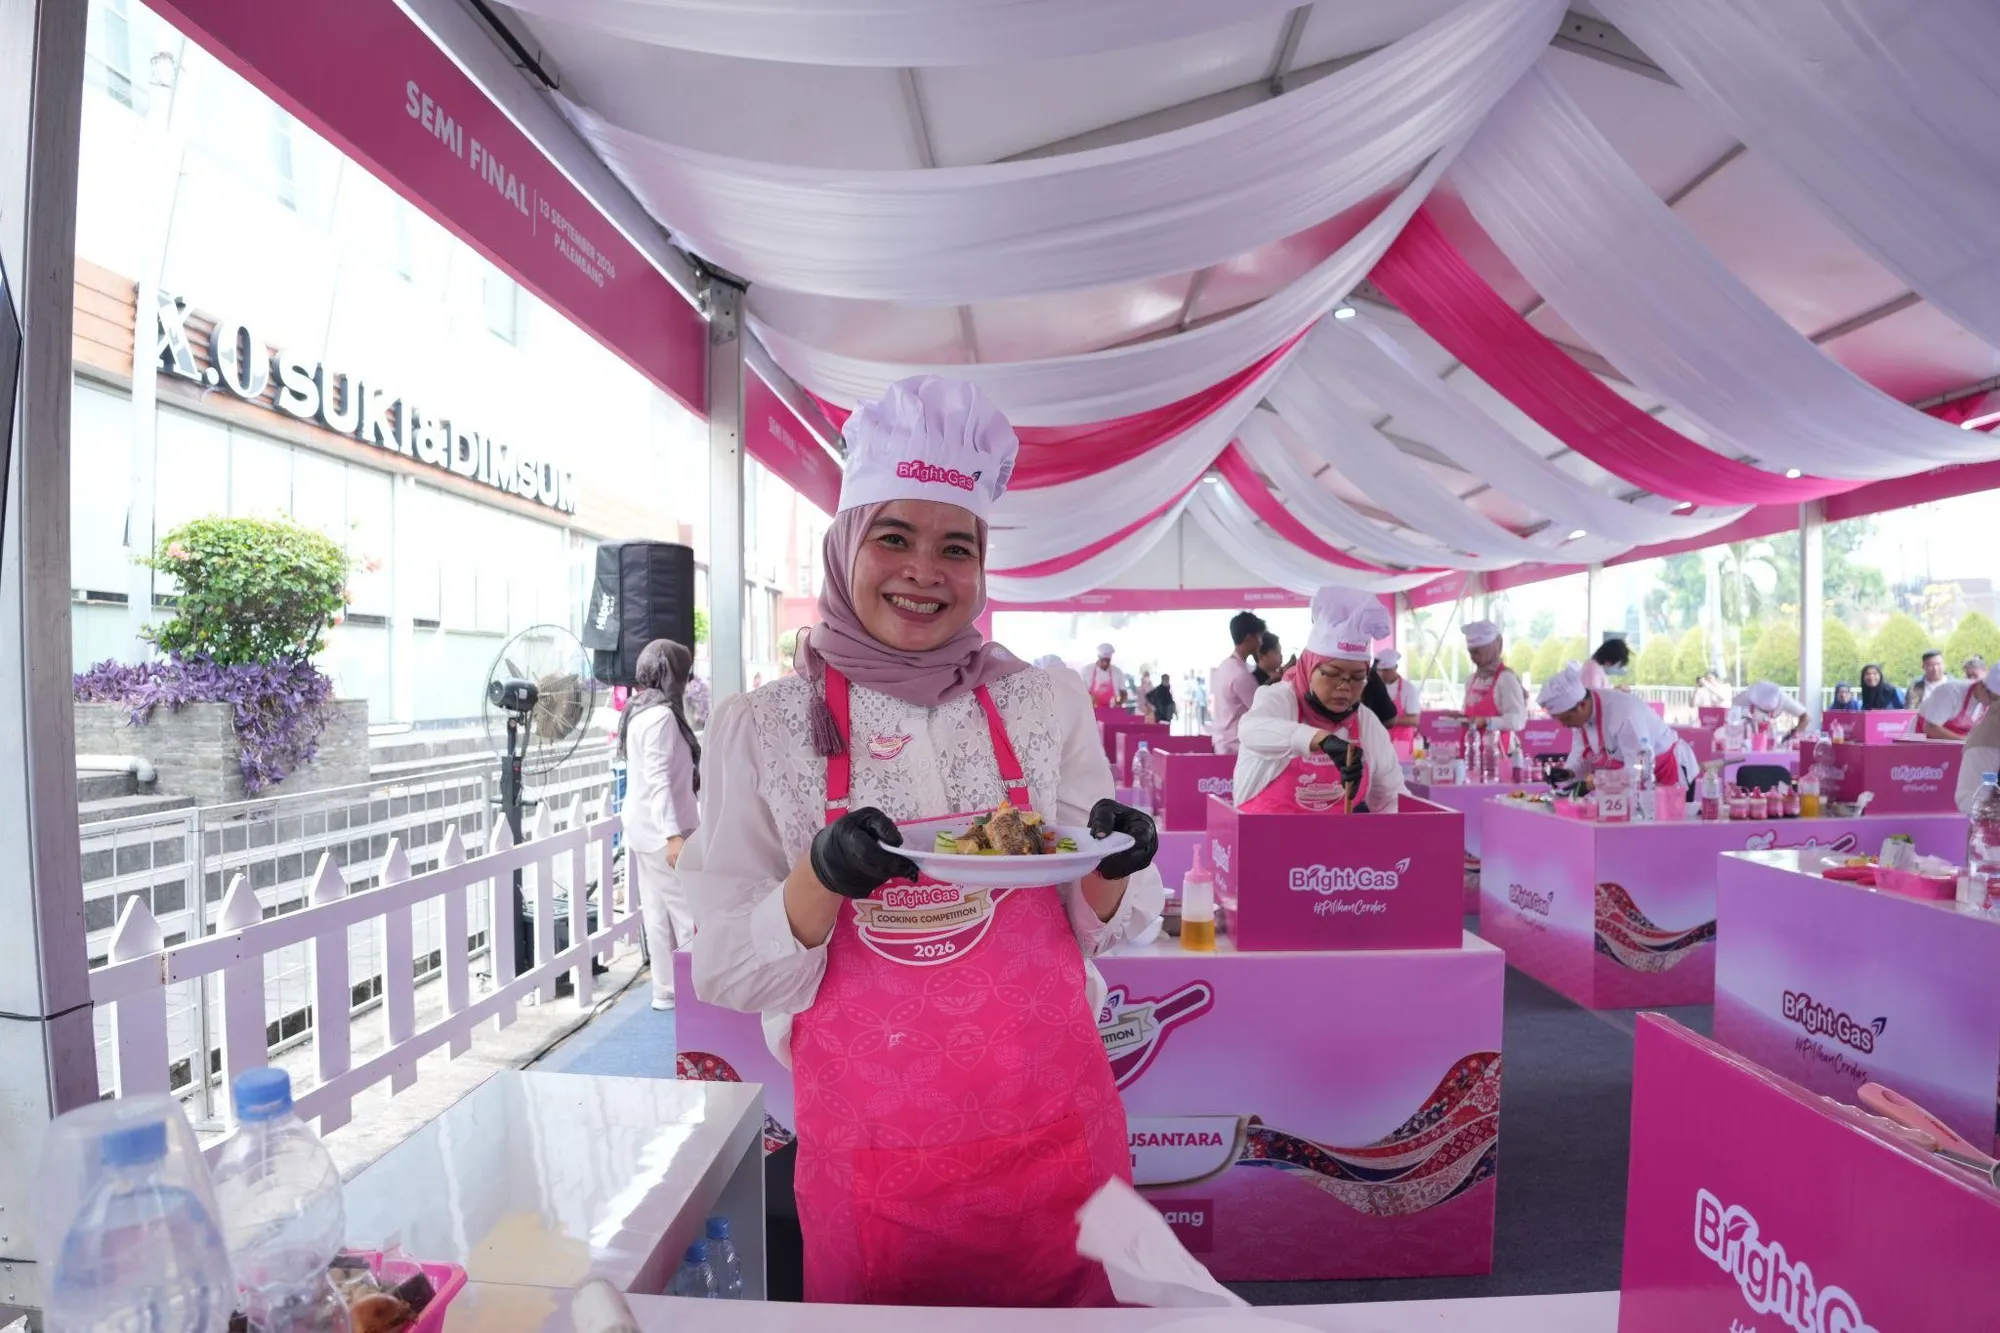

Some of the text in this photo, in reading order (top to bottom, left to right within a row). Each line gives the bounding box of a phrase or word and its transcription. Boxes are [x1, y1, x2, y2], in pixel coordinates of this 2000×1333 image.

[405, 79, 529, 217] SEMI FINAL
[539, 197, 550, 220] 13
[551, 210, 596, 260] SEPTEMBER
[554, 232, 604, 288] PALEMBANG
[897, 460, 975, 491] Bright Gas
[1605, 799, 1622, 811] 26
[1289, 864, 1399, 895] Bright Gas
[886, 888, 960, 908] Bright Gas
[877, 906, 977, 924] COOKING COMPETITION
[913, 941, 956, 957] 2026
[1783, 990, 1873, 1055] Bright Gas
[1695, 1188, 1817, 1333] Bright
